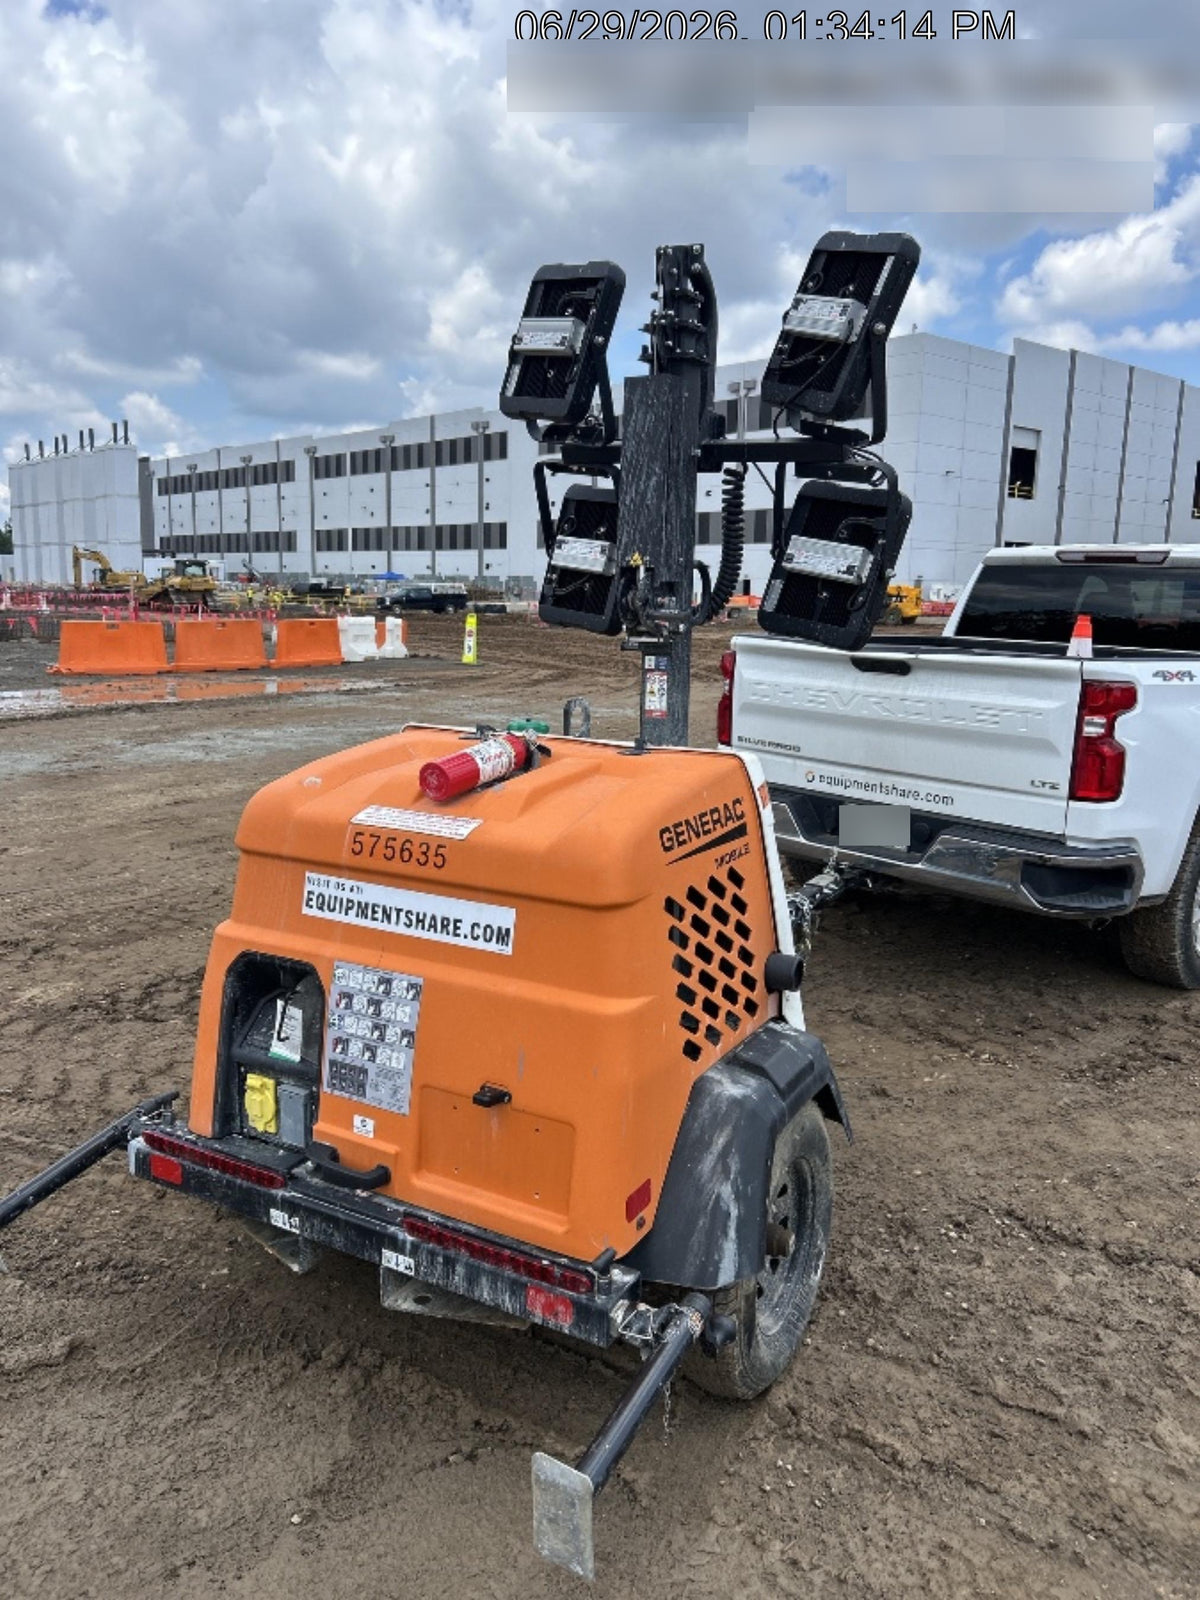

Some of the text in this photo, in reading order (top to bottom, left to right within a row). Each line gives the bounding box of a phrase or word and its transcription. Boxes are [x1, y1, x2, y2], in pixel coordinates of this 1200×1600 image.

[749, 681, 1043, 732] CHEVROLET
[737, 735, 801, 753] SILVERADO
[819, 773, 955, 806] equipmentshare.com
[1030, 779, 1060, 790] LTZ
[659, 797, 745, 853] GENERAC
[351, 831, 448, 868] 575635
[714, 842, 751, 869] MOBILE
[307, 875, 332, 889] VISIT
[304, 889, 512, 947] EQUIPMENTSHARE.COM
